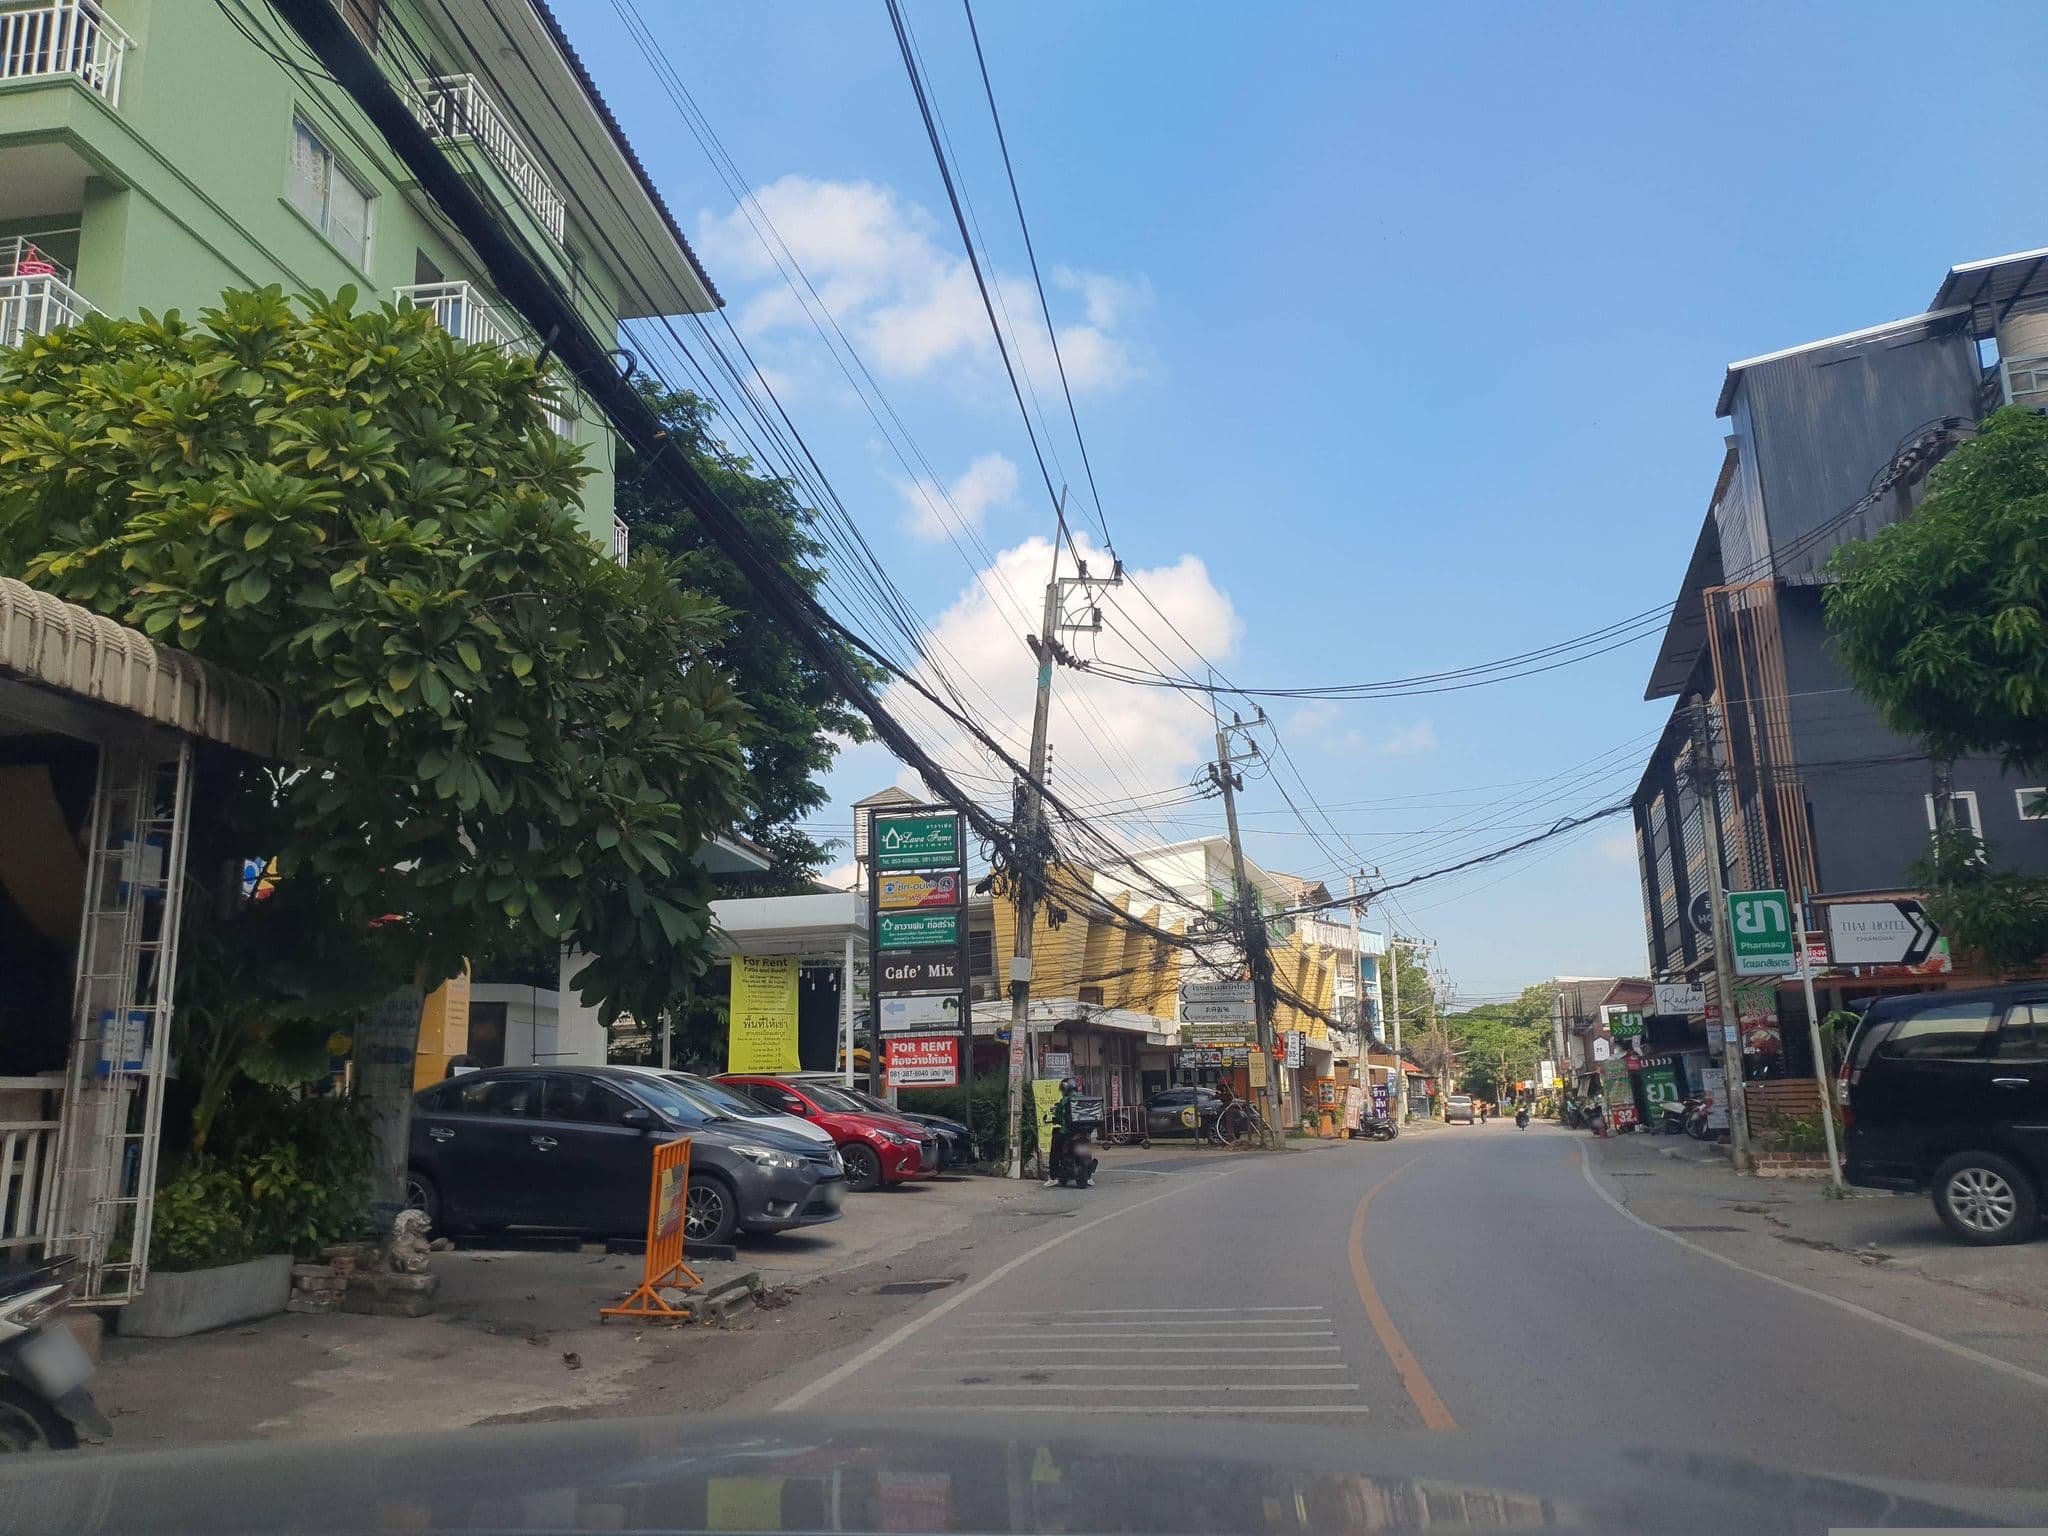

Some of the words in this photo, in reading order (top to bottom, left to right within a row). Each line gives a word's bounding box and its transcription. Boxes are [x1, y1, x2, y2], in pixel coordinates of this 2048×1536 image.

[1736, 900, 1785, 934] ยา
[1840, 921, 1866, 932] THAI
[1871, 920, 1906, 931] HOTEL
[1740, 940, 1786, 950] Pharmacy
[743, 955, 760, 967] For
[762, 957, 788, 968] Rent
[928, 964, 954, 978] Mix
[1658, 988, 1701, 1013] Racha
[892, 1042, 916, 1053] FOR
[921, 1041, 953, 1053] RENT
[1647, 1082, 1679, 1103] ยา
